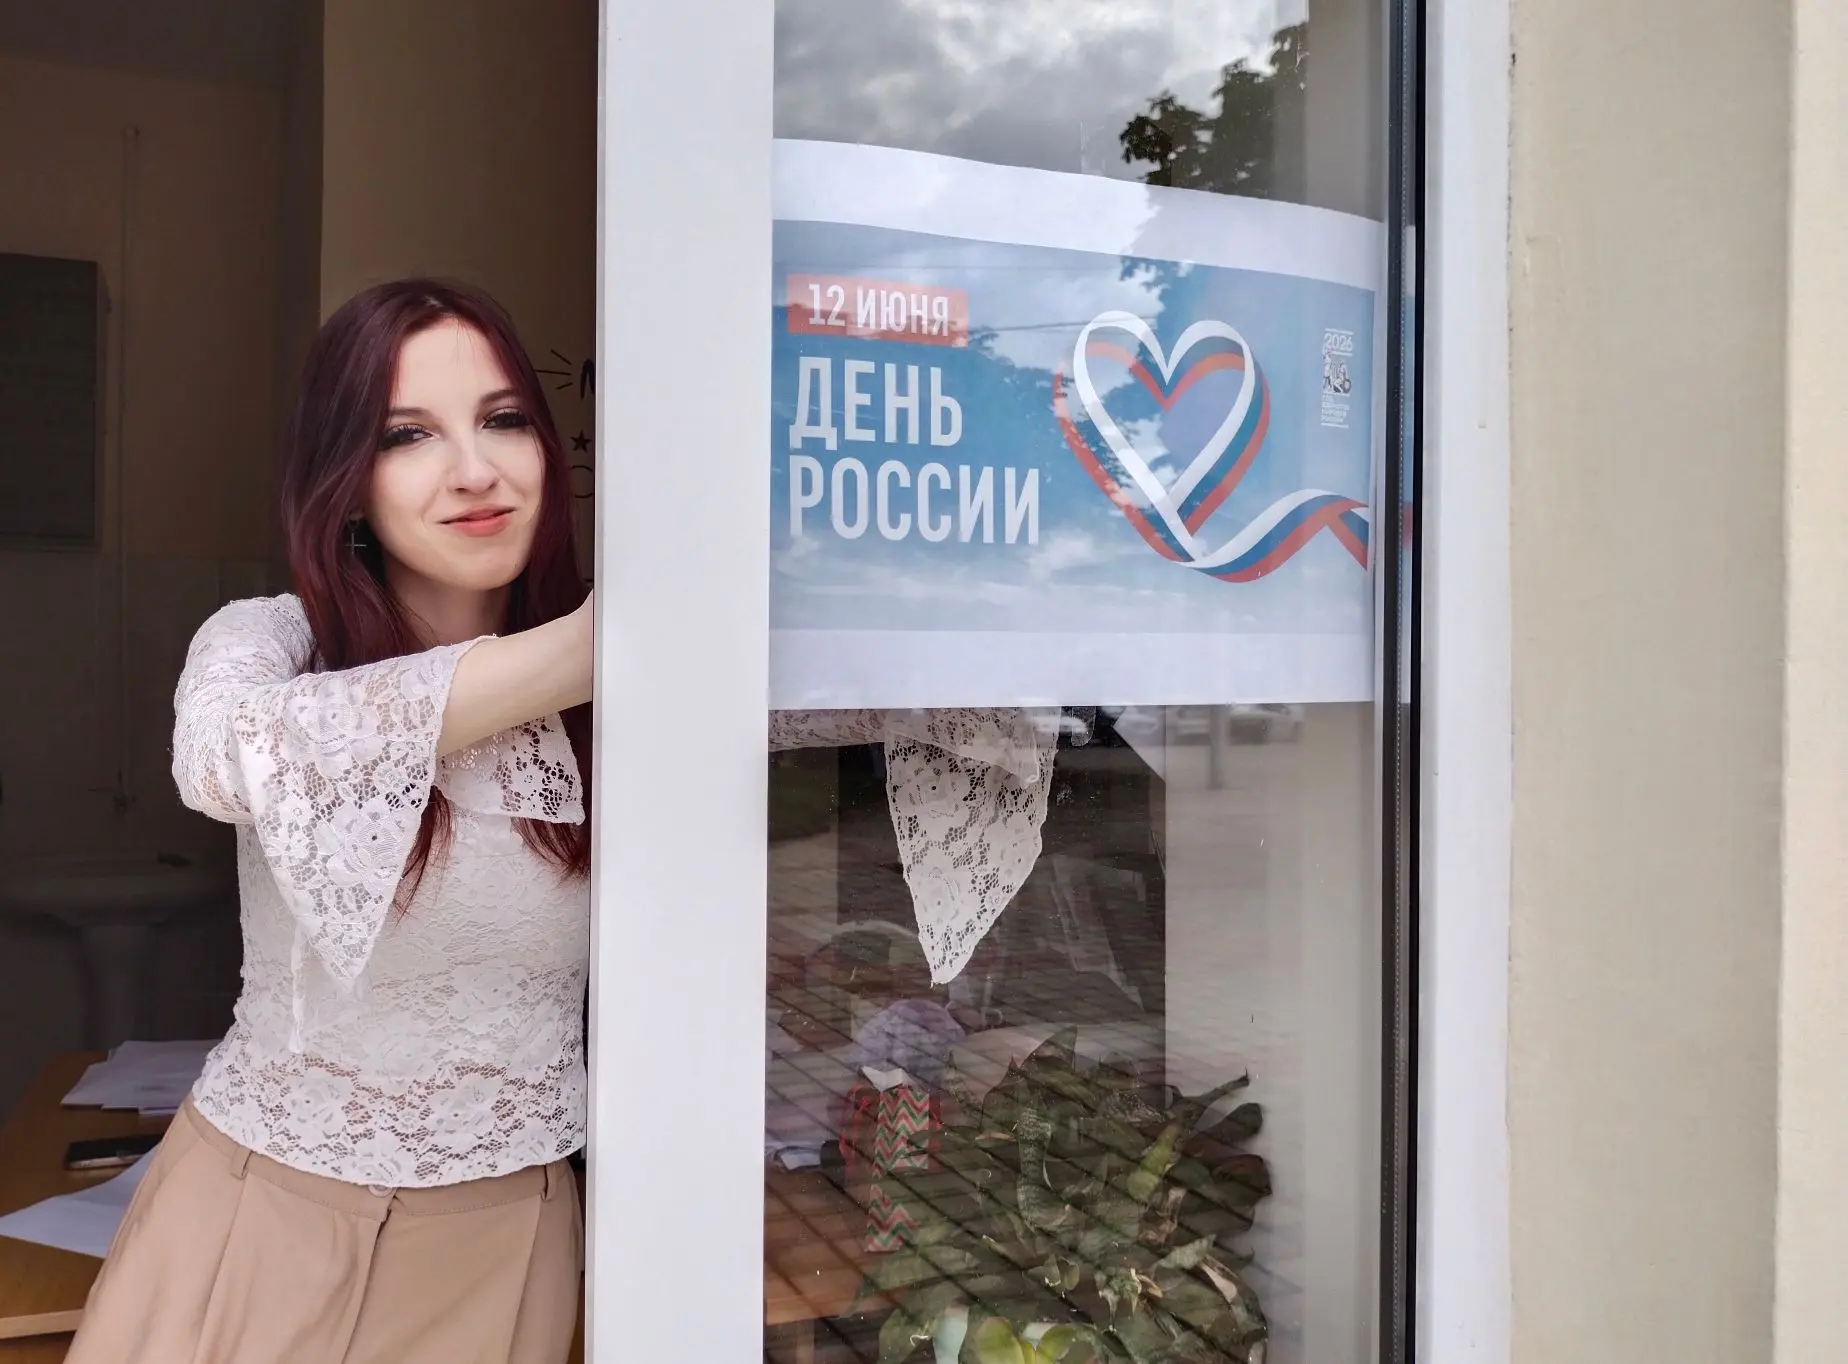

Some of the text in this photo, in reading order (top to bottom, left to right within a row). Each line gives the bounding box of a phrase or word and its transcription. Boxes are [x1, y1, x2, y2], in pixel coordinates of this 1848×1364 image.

[808, 284, 949, 337] 12 ИЮНЯ
[1324, 333, 1353, 351] 2026
[789, 356, 963, 450] ДЕНЬ
[789, 455, 1039, 546] РОССИИ
